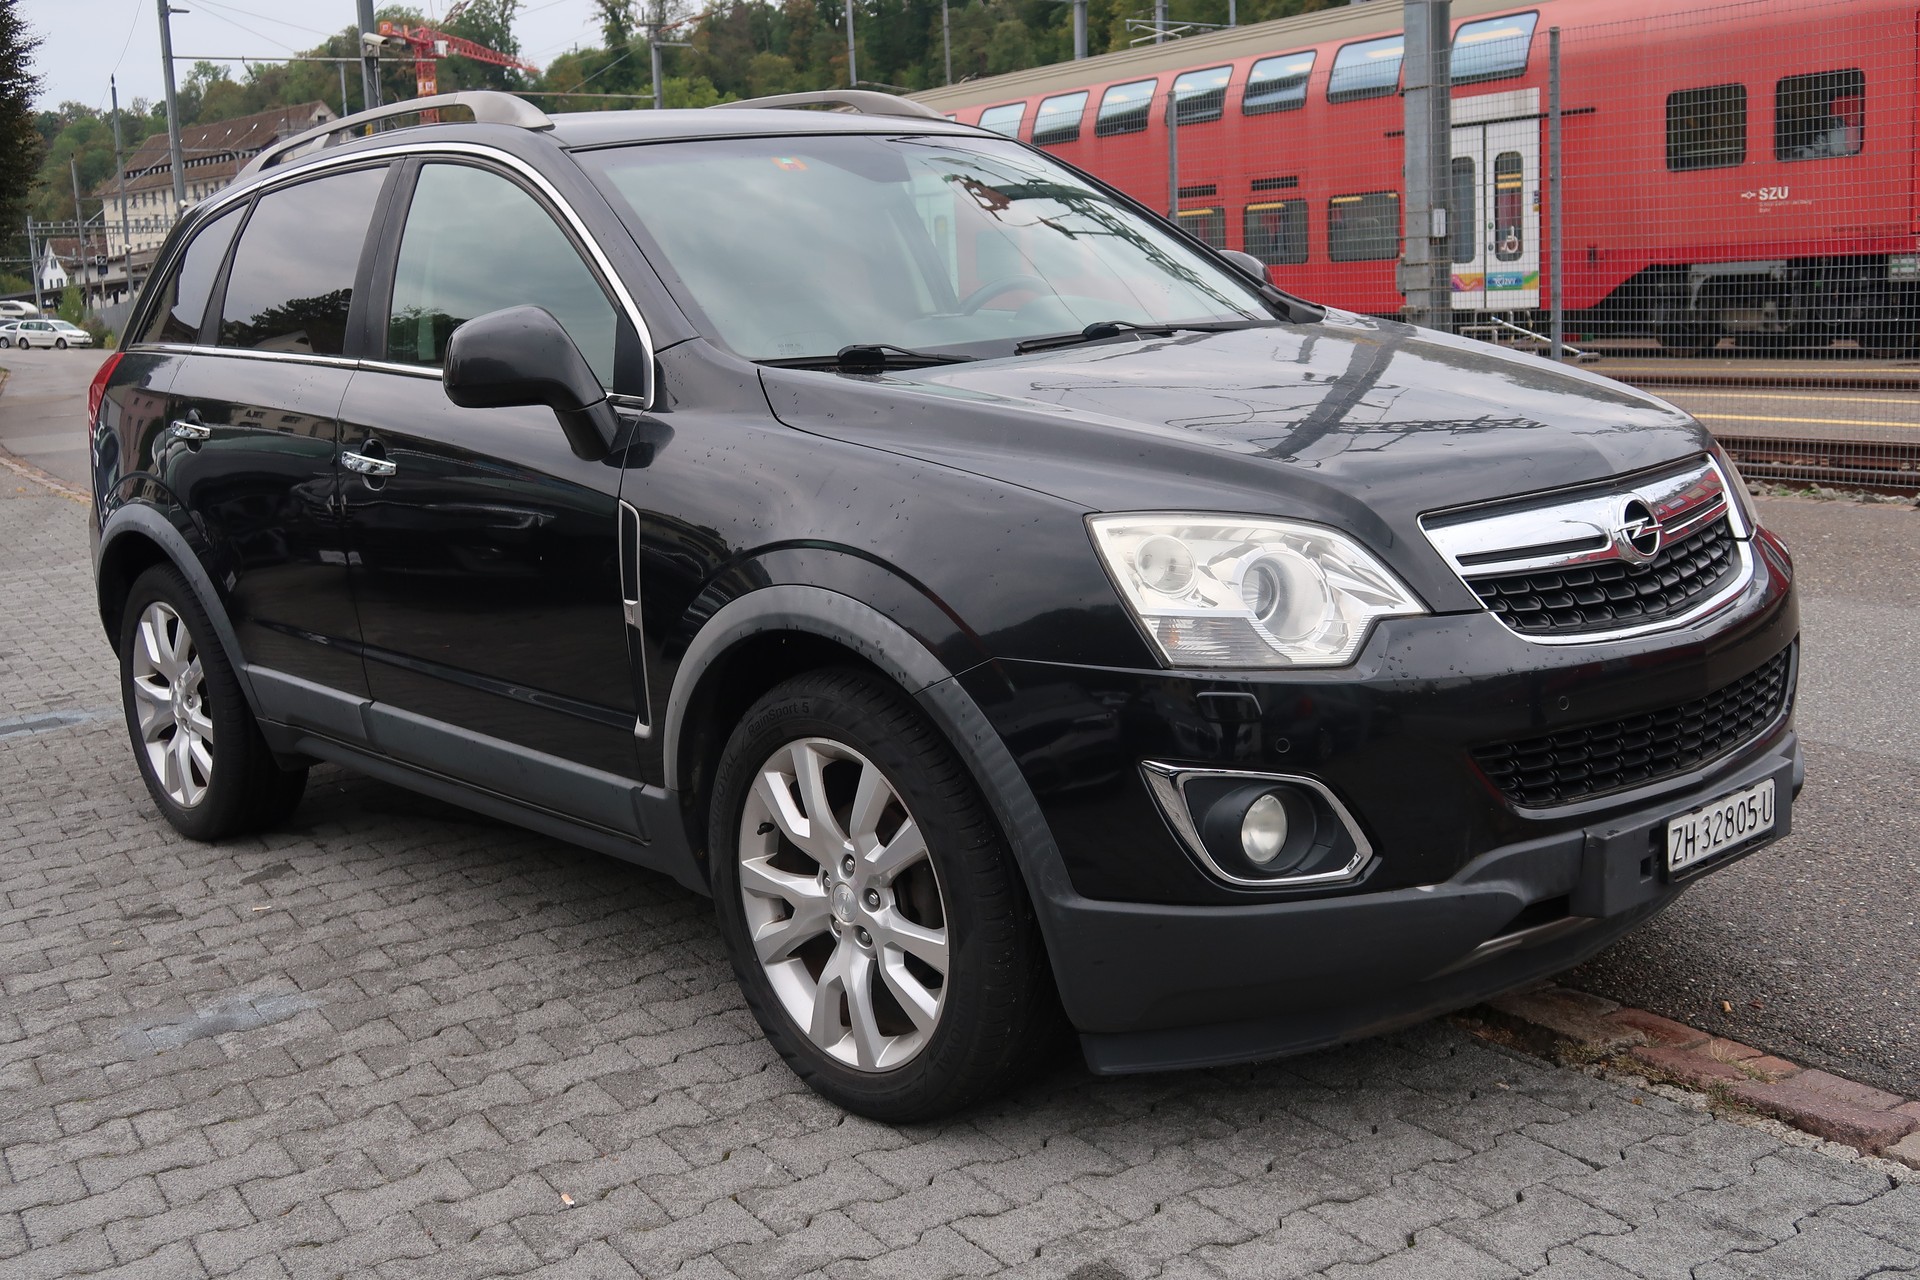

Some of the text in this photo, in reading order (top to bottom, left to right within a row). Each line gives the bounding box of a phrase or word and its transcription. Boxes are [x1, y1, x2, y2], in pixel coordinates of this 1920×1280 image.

[1759, 186, 1789, 201] SZU
[747, 702, 799, 736] RainSport
[802, 701, 810, 713] 5
